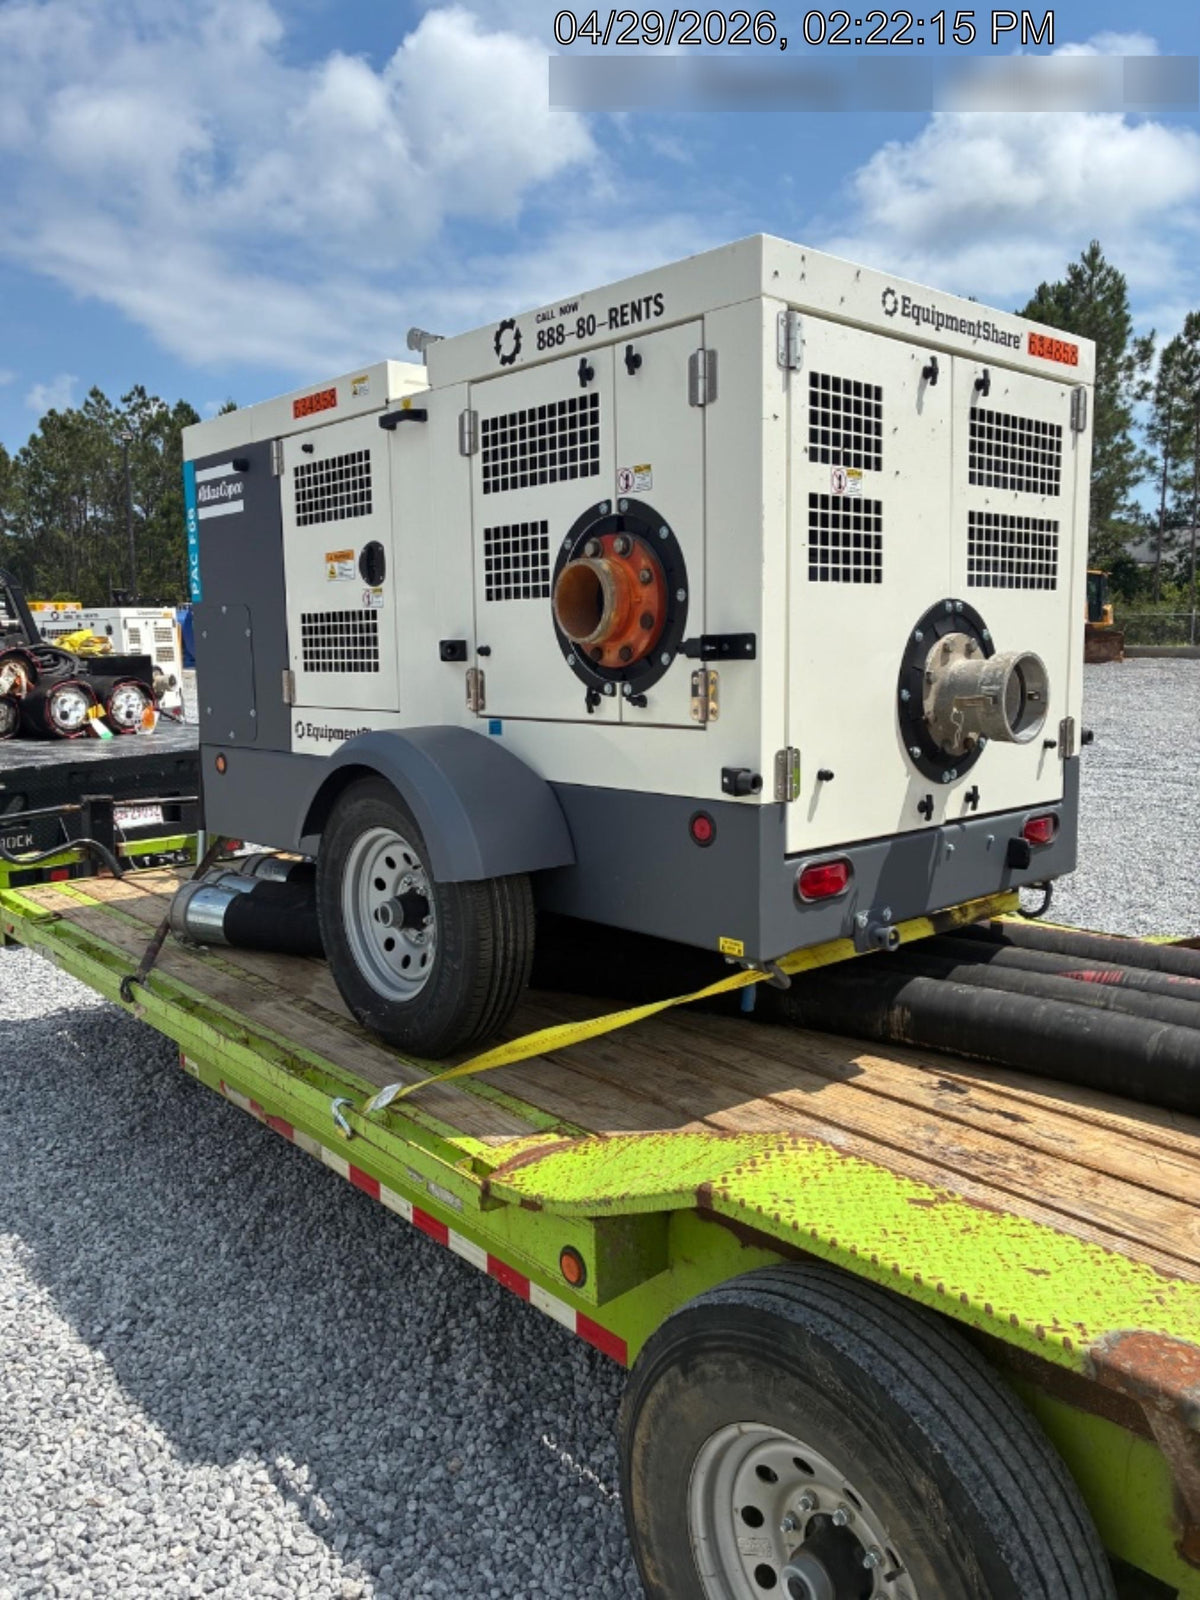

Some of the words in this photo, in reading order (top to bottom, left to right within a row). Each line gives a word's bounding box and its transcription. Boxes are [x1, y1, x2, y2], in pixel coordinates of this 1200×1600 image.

[535, 309, 556, 324] CALL
[559, 301, 580, 317] NOW
[536, 292, 665, 351] 888-80-RENTS
[901, 294, 1020, 349] EquipmentShare
[189, 552, 200, 594] PAC
